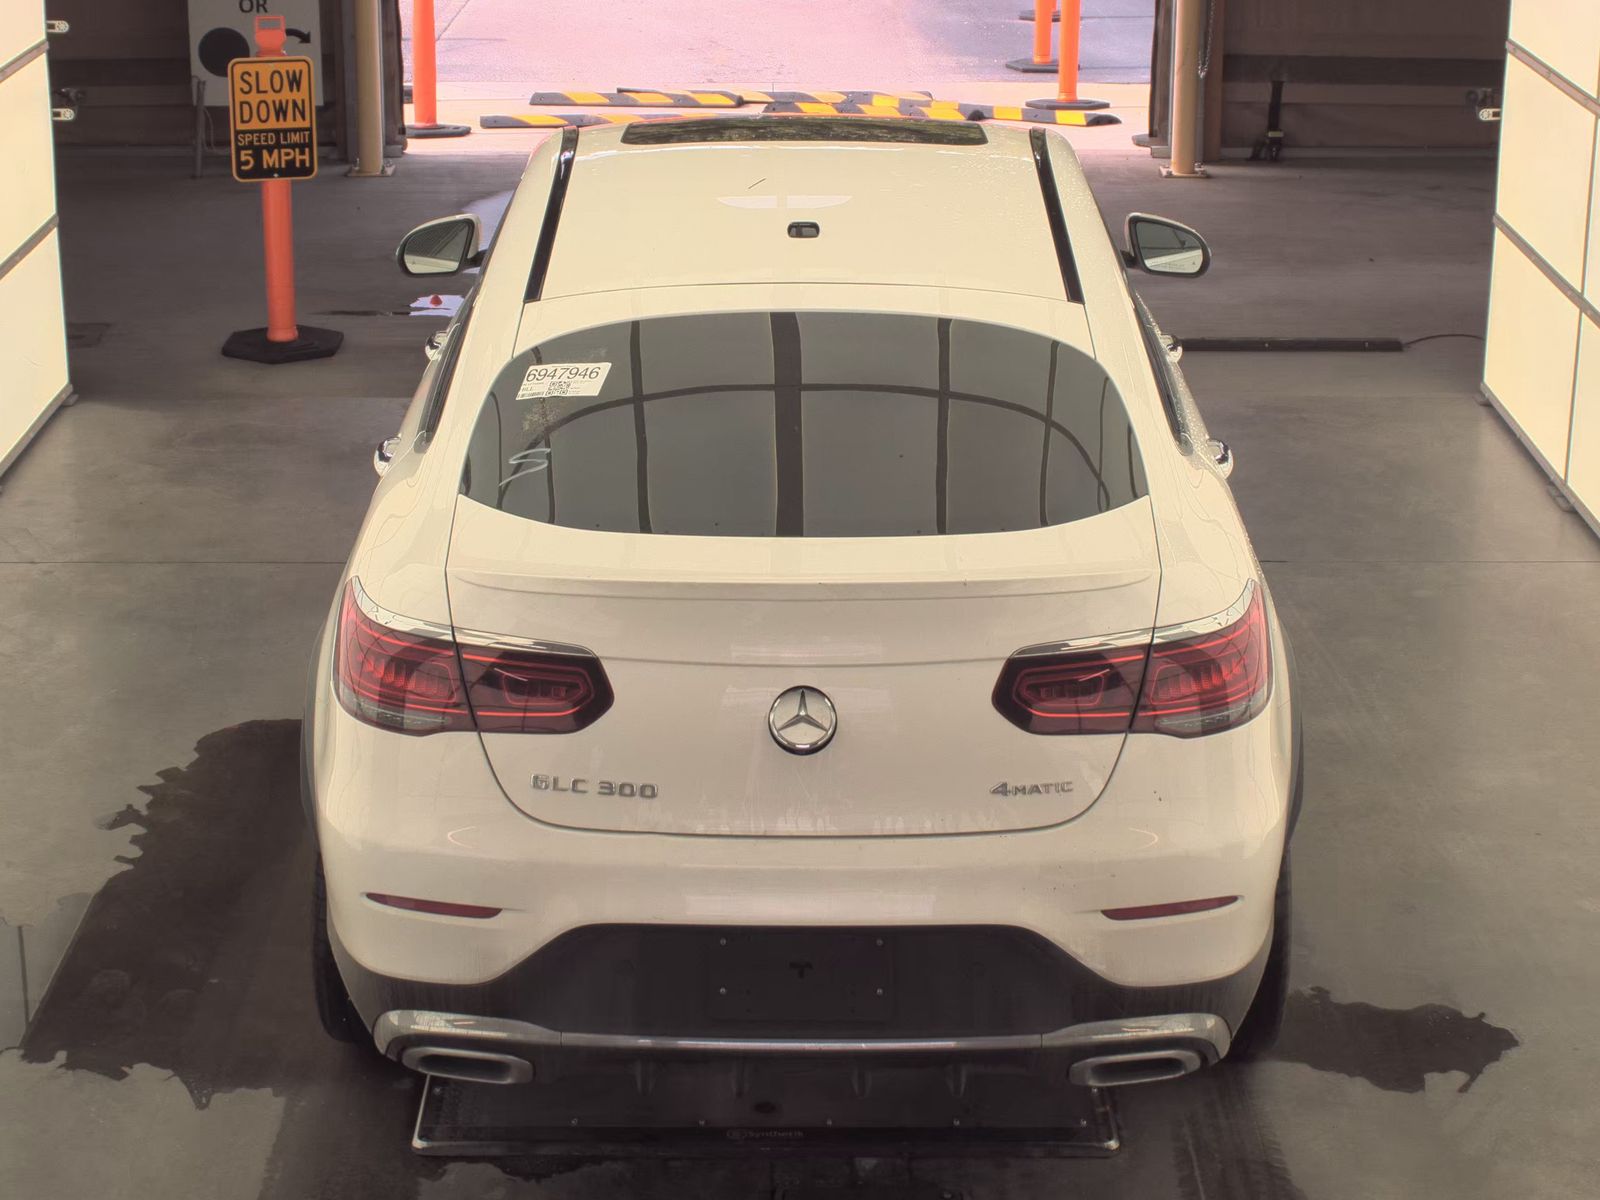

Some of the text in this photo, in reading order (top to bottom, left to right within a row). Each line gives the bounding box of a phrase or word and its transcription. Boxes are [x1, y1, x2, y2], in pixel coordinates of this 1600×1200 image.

[239, 0, 268, 13] OR
[239, 69, 303, 95] SLOW
[239, 98, 306, 124] DOWN
[237, 131, 311, 146] SPEED LIMIT
[240, 148, 310, 170] 5 MPH
[526, 366, 601, 383] 6947946
[530, 774, 658, 799] GLC 300
[989, 781, 1073, 797] 4MATIC
